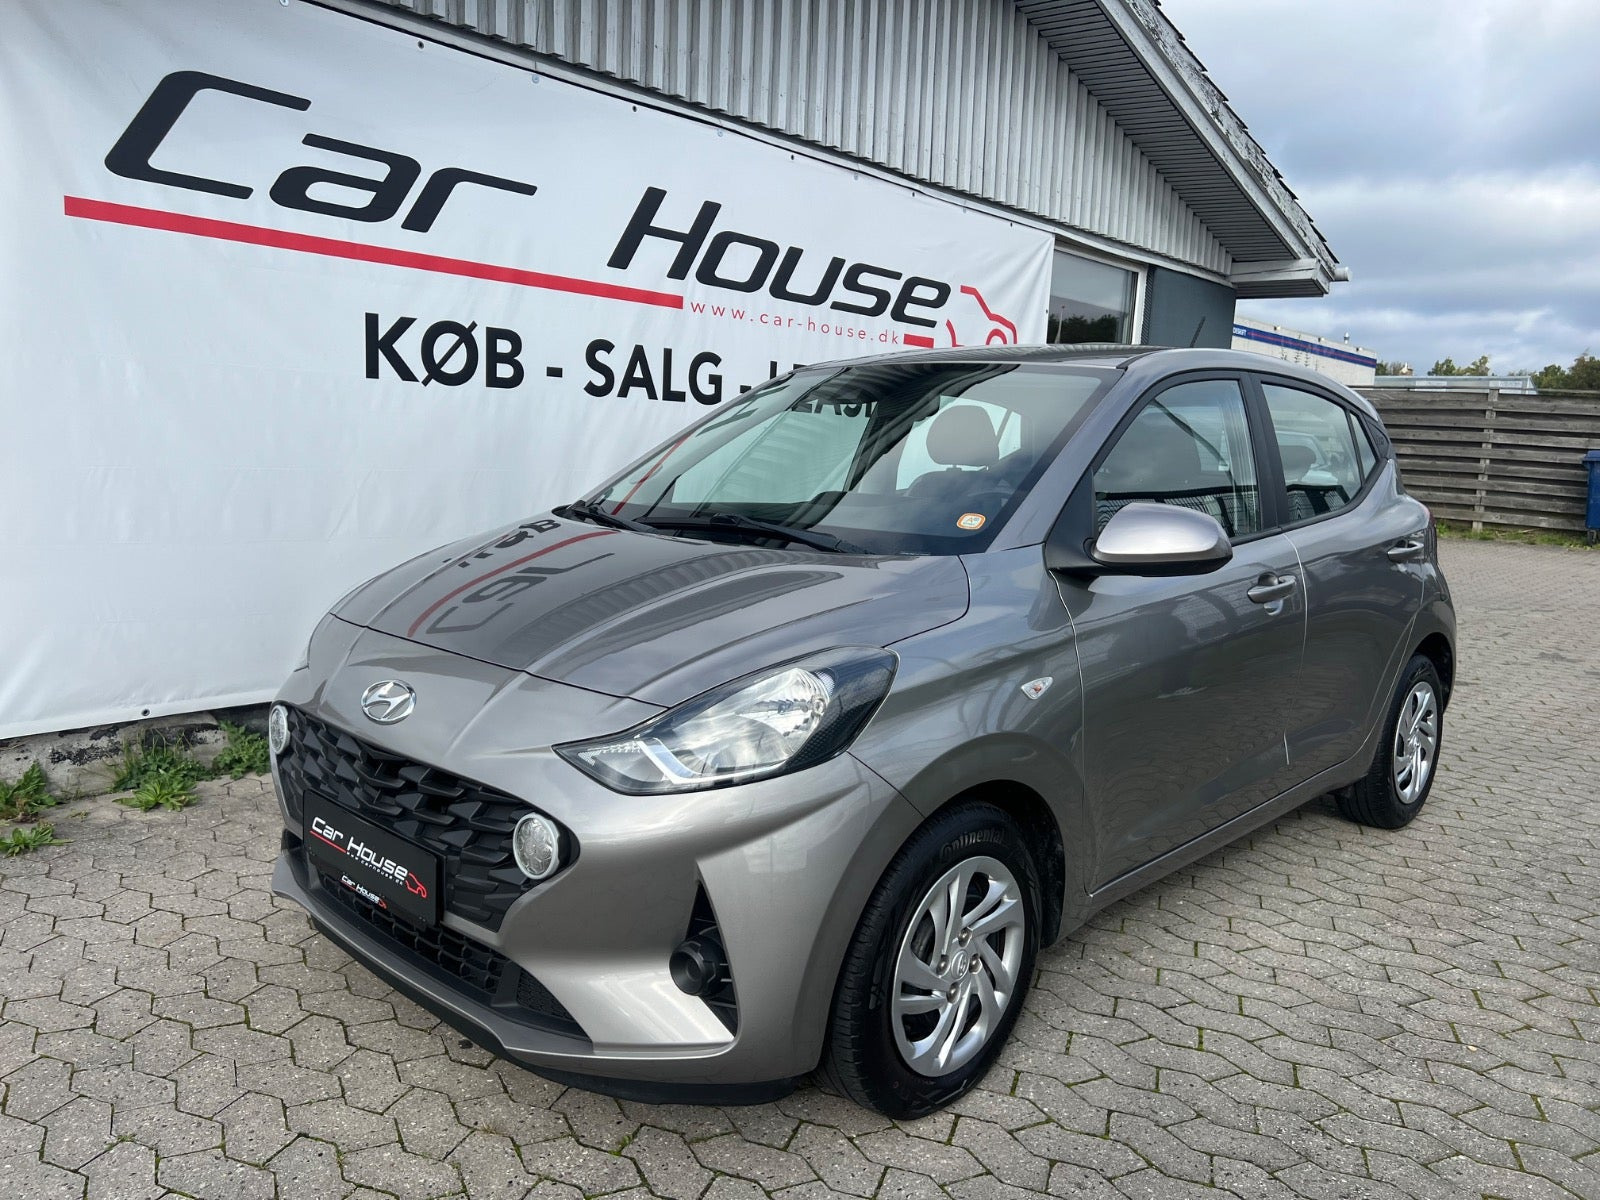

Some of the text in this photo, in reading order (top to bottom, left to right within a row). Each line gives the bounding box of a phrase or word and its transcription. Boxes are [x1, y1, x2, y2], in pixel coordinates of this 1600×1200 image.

[104, 70, 952, 328] Car House
[690, 301, 900, 345] www.car-house.dk
[364, 312, 525, 389] KØB
[583, 338, 724, 406] SALG
[311, 816, 408, 881] Car House
[341, 874, 380, 904] Car House
